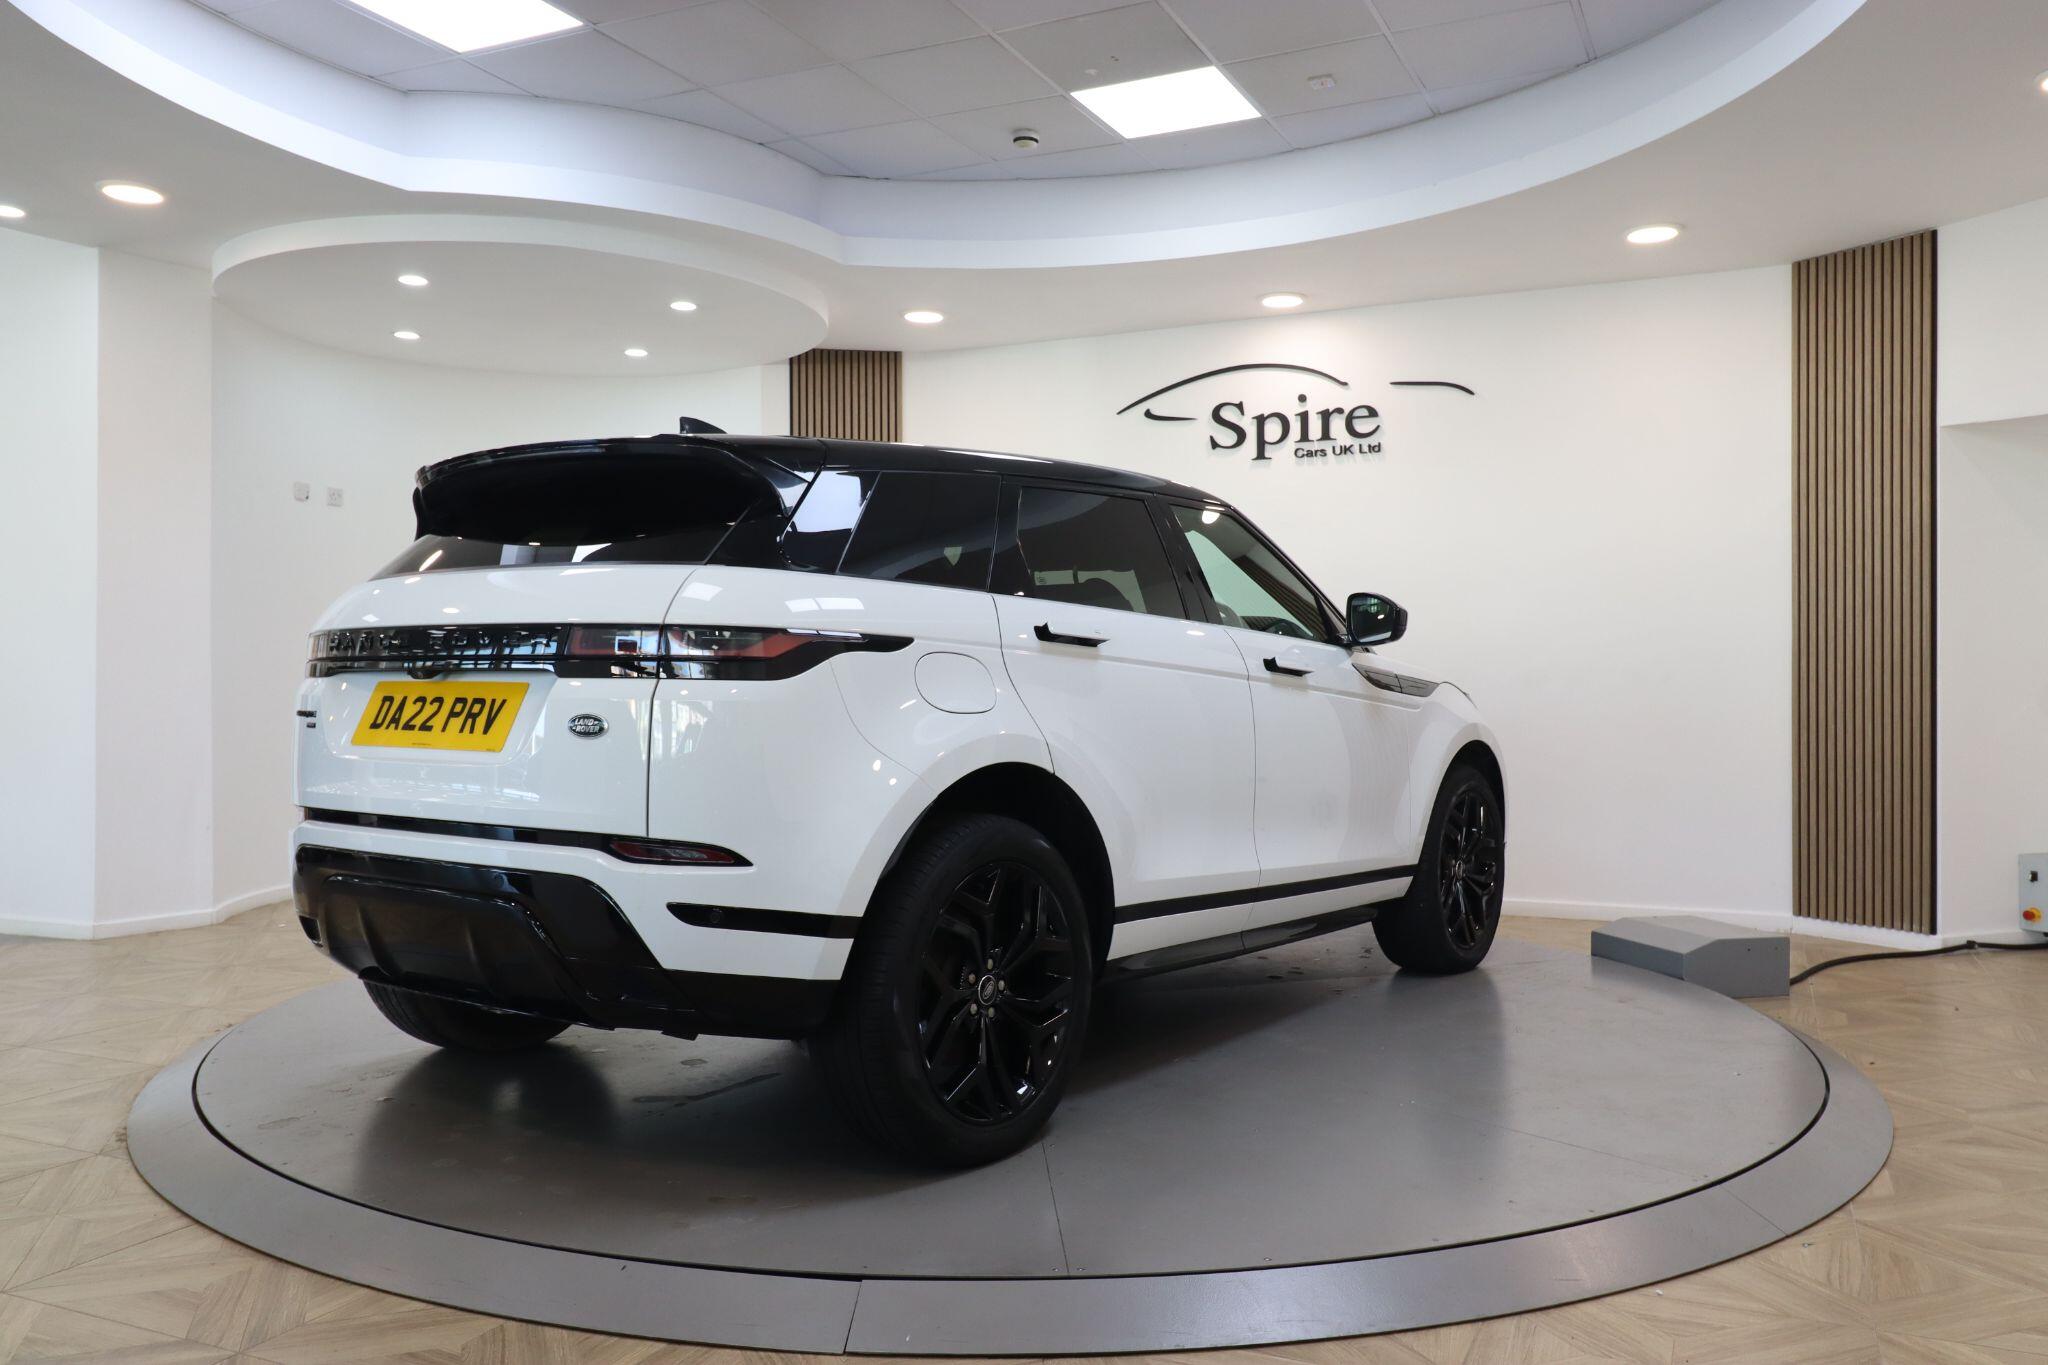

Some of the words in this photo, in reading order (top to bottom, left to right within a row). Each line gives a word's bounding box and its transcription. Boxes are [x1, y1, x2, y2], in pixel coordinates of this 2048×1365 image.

[1209, 394, 1381, 461] Spire
[1294, 447, 1327, 458] Cars
[1332, 444, 1354, 456] UK
[1358, 442, 1381, 454] Ltd
[369, 695, 445, 732] DA22
[440, 697, 508, 735] PRV
